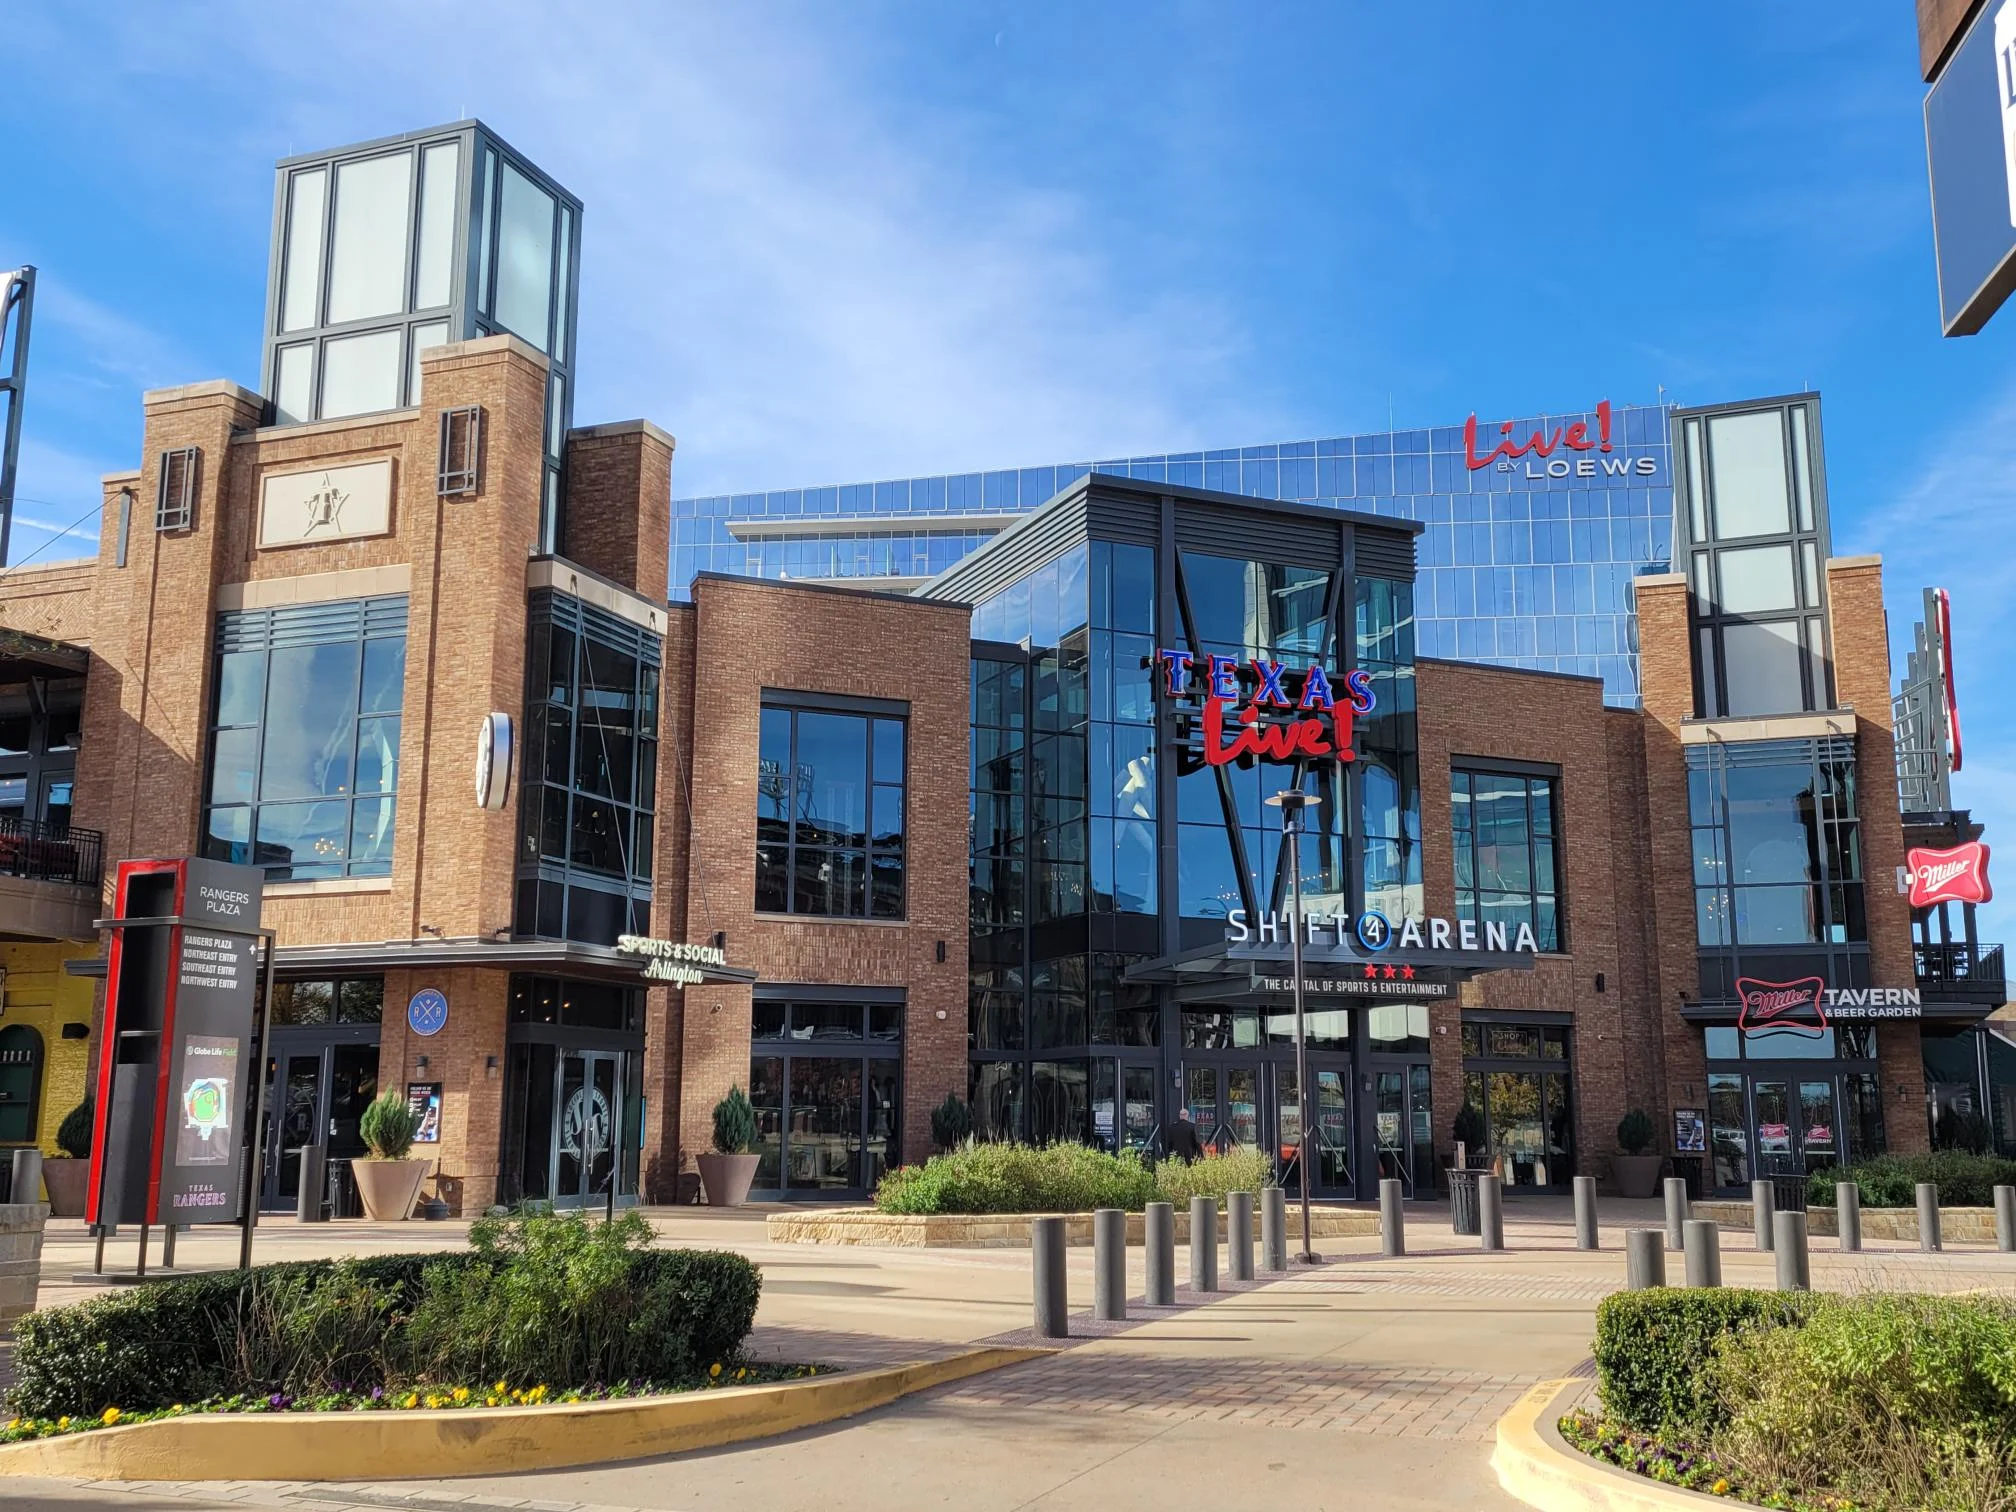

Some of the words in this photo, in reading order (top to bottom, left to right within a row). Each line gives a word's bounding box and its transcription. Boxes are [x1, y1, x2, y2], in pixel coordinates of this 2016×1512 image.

[1464, 400, 1614, 470] Live!
[1497, 462, 1520, 472] BY
[1526, 458, 1657, 479] LOEWS
[1156, 648, 1377, 716] TEXAS
[1202, 698, 1356, 766] Live!
[1917, 859, 1971, 893] Miller
[200, 886, 250, 904] RANGERS
[206, 901, 241, 916] PLAZA
[1227, 909, 1349, 945] SHIFT
[1400, 917, 1539, 953] ARENA
[184, 935, 213, 947] RANGERS
[214, 940, 232, 950] PLAZA
[619, 935, 672, 958] SPORTS
[674, 943, 682, 959] &
[684, 944, 726, 965] SOCIAL
[183, 949, 218, 961] NORTHEAST
[219, 953, 238, 963] ENTRY
[182, 962, 217, 974] SOUTHEAST
[217, 966, 237, 976] ENTRY
[645, 958, 704, 990] Arlington
[181, 975, 218, 988] NORTHWEST
[219, 979, 238, 989] ENTRY
[1264, 978, 1281, 990] THE
[1283, 979, 1320, 991] CATAL
[1323, 980, 1332, 992] OF
[1336, 980, 1369, 993] SPORTS
[1371, 982, 1377, 993] &
[1380, 982, 1448, 996] ENTERTAINMENT
[1747, 989, 1813, 1018] Miller
[1824, 988, 1920, 1006] TAVERN
[1825, 1008, 1833, 1018] &
[1835, 1008, 1865, 1018] BEER
[1867, 1007, 1922, 1017] GARDEN
[194, 1046, 211, 1055] Globe
[211, 1047, 222, 1056] Life
[189, 1184, 213, 1193] TEXAS
[173, 1193, 226, 1207] RANGERS
